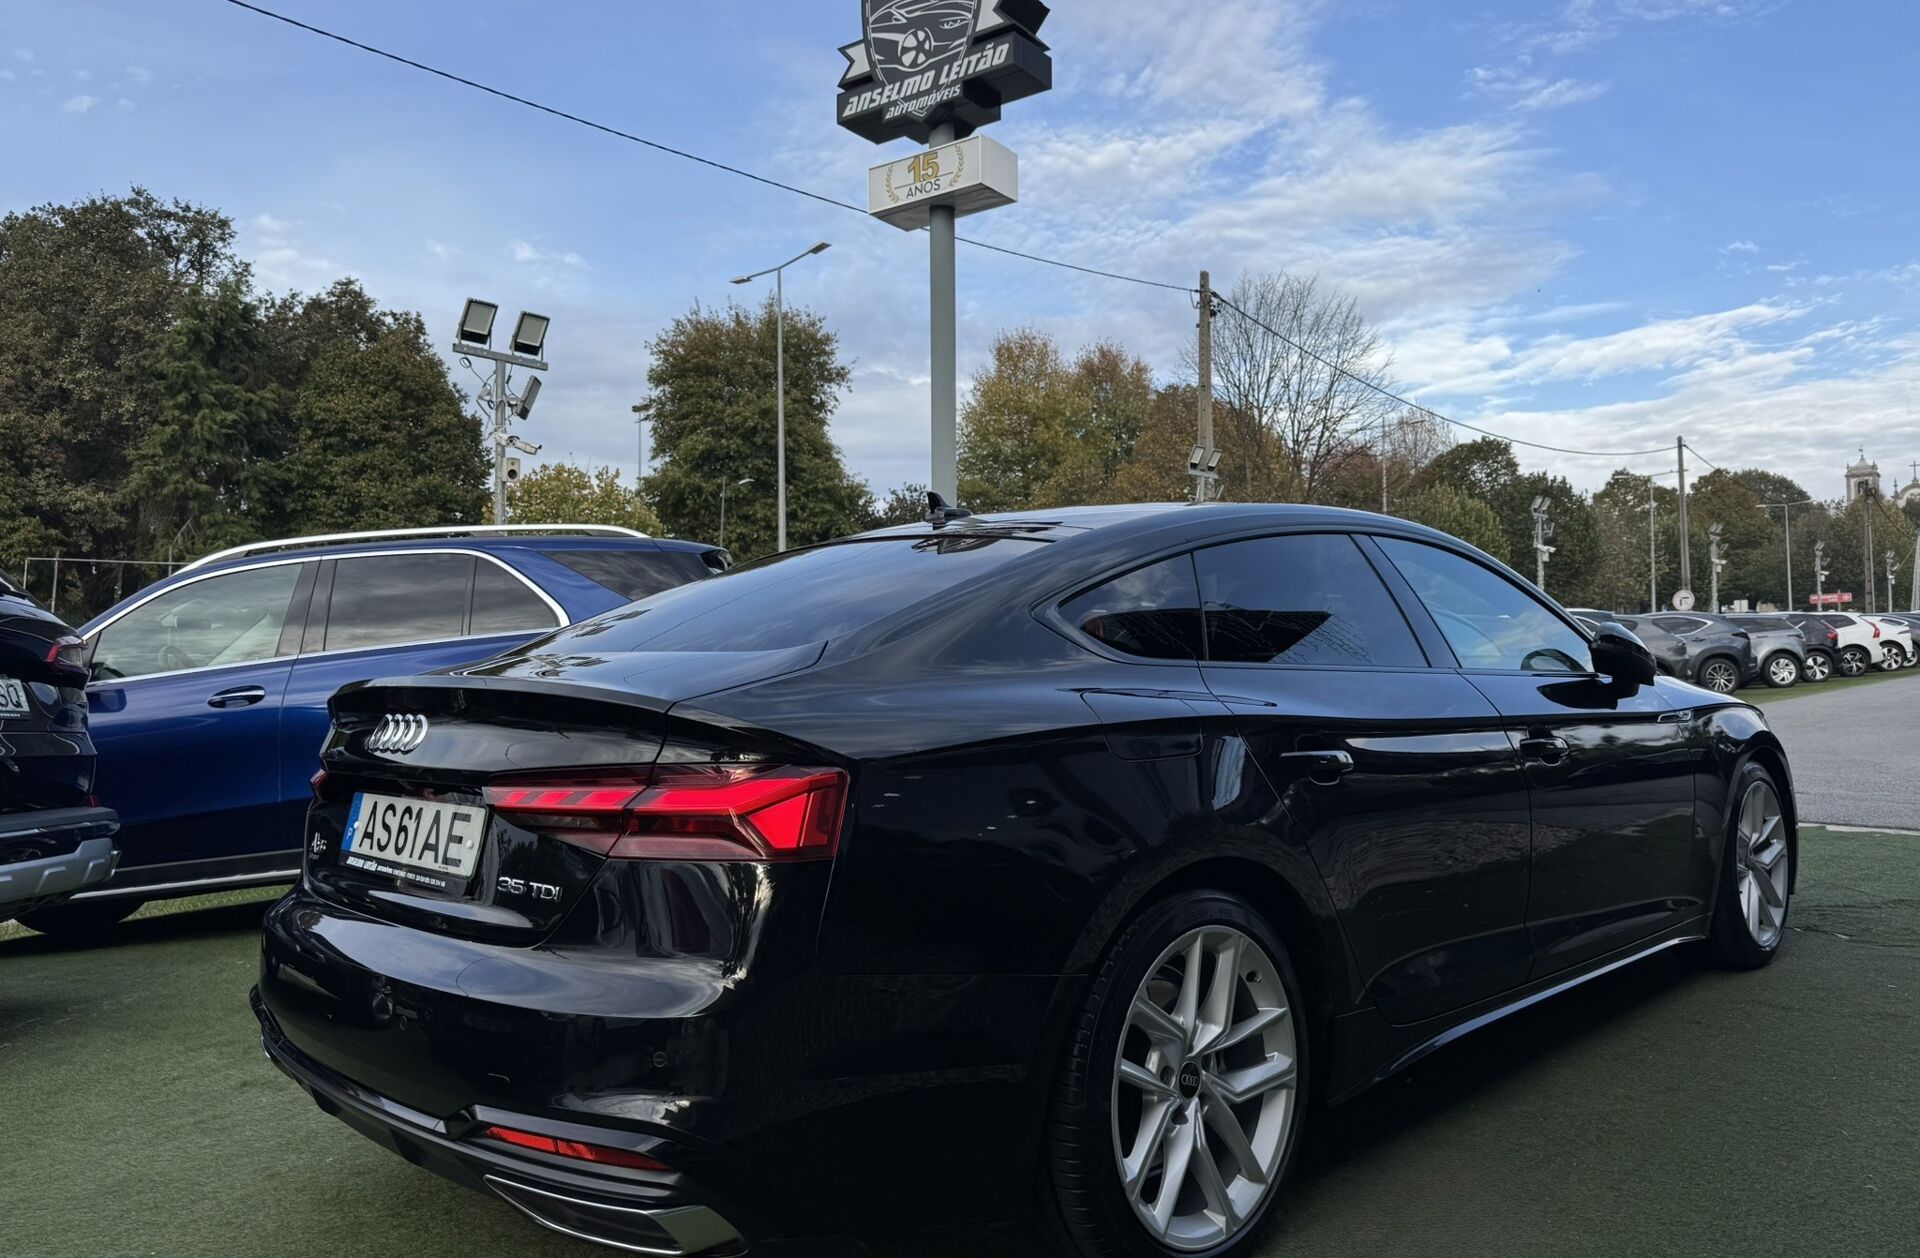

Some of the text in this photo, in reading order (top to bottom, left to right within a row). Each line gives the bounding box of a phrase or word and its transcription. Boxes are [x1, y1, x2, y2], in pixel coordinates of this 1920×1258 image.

[842, 42, 1010, 118] ANSELMO LEITÃO
[907, 151, 940, 183] 15
[906, 178, 941, 198] ANOS
[359, 801, 472, 867] AS61AE
[497, 876, 561, 900] 35 TDI
